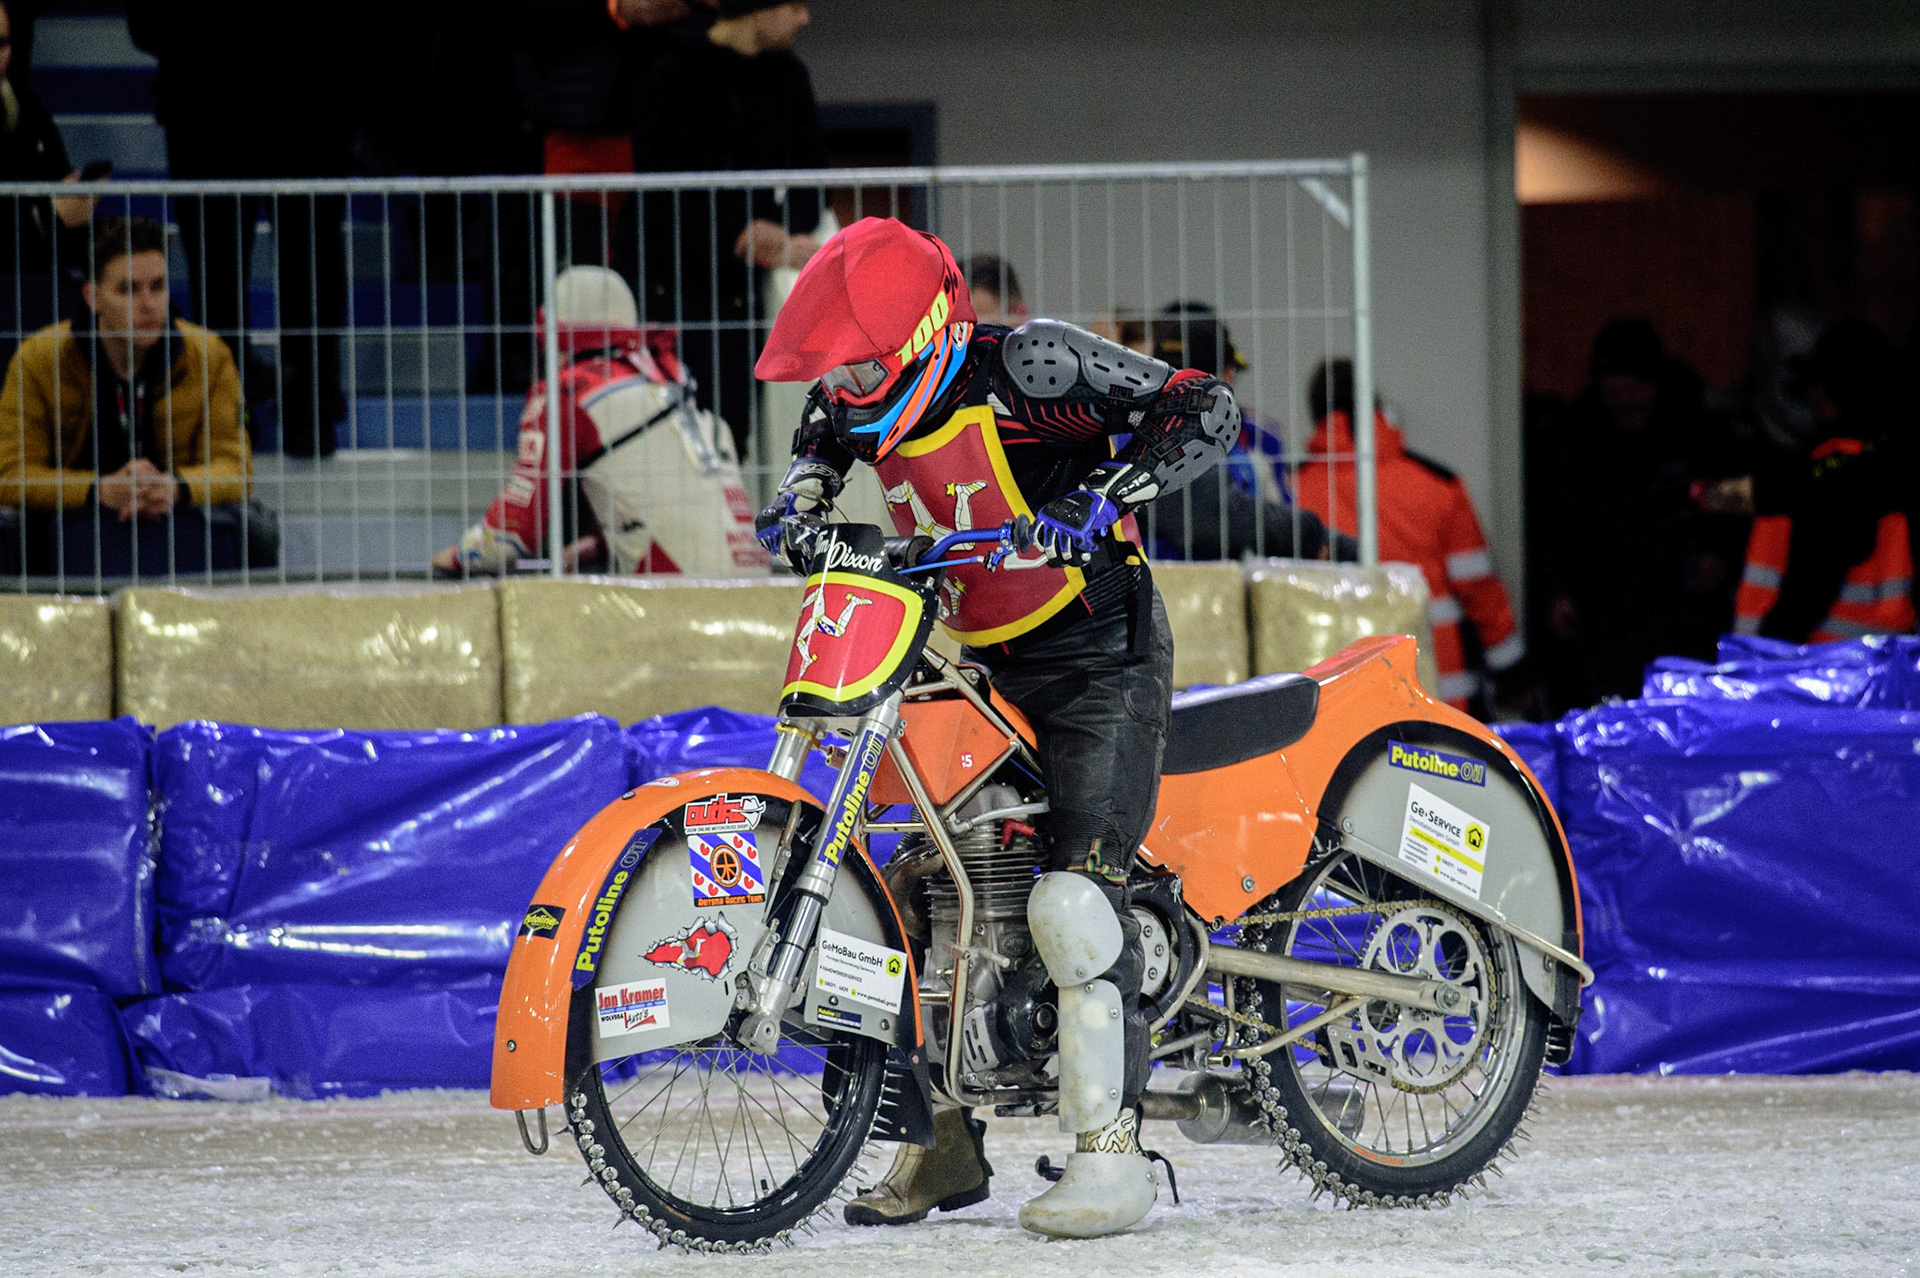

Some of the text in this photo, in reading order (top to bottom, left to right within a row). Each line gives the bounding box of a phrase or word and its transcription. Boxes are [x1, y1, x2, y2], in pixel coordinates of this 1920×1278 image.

[828, 541, 883, 572] Dixon
[1391, 745, 1484, 784] Putoline Oil
[824, 734, 883, 865] Putoline Oil
[575, 841, 649, 972] Putoline Oil
[821, 940, 883, 968] GeMoBau GmbH
[598, 992, 618, 1010] Jan
[620, 987, 665, 1006] Kramer
